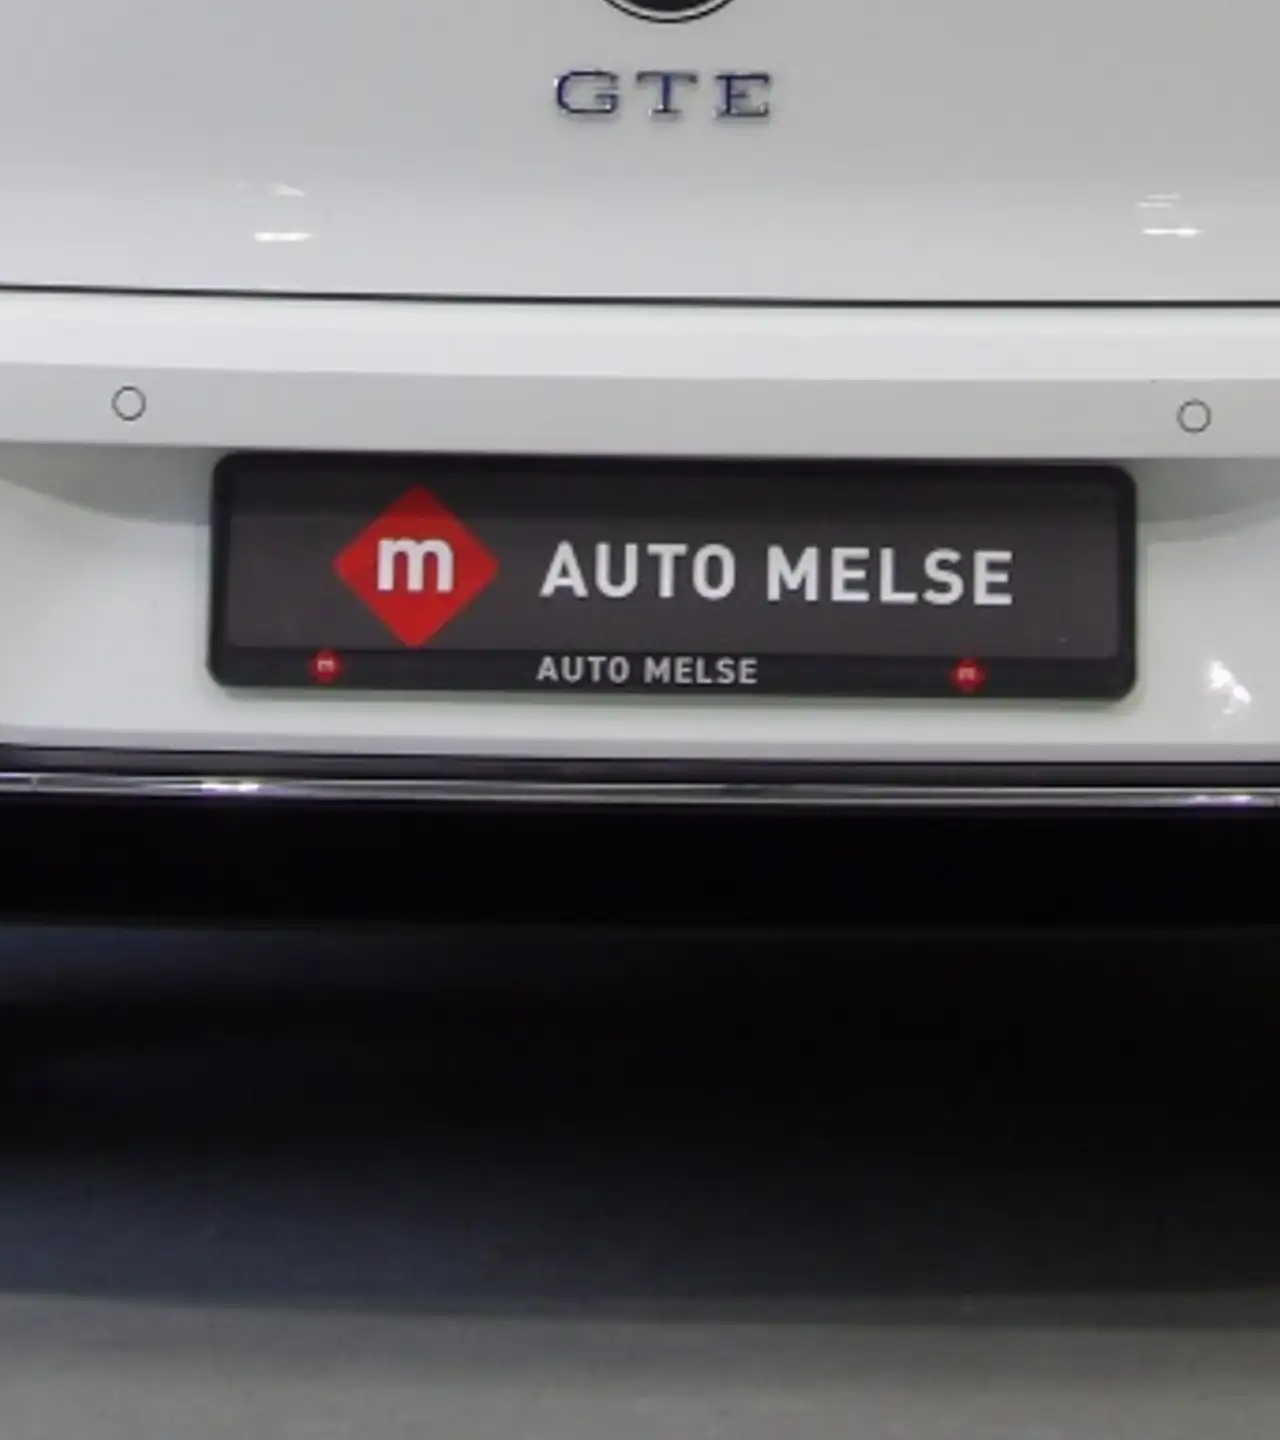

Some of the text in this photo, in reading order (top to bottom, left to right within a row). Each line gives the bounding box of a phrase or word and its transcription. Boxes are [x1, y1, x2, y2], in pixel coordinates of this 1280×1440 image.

[554, 69, 773, 120] GTE
[376, 537, 1014, 606] m AUTO MELSE
[536, 655, 758, 685] AUTO MELSE
